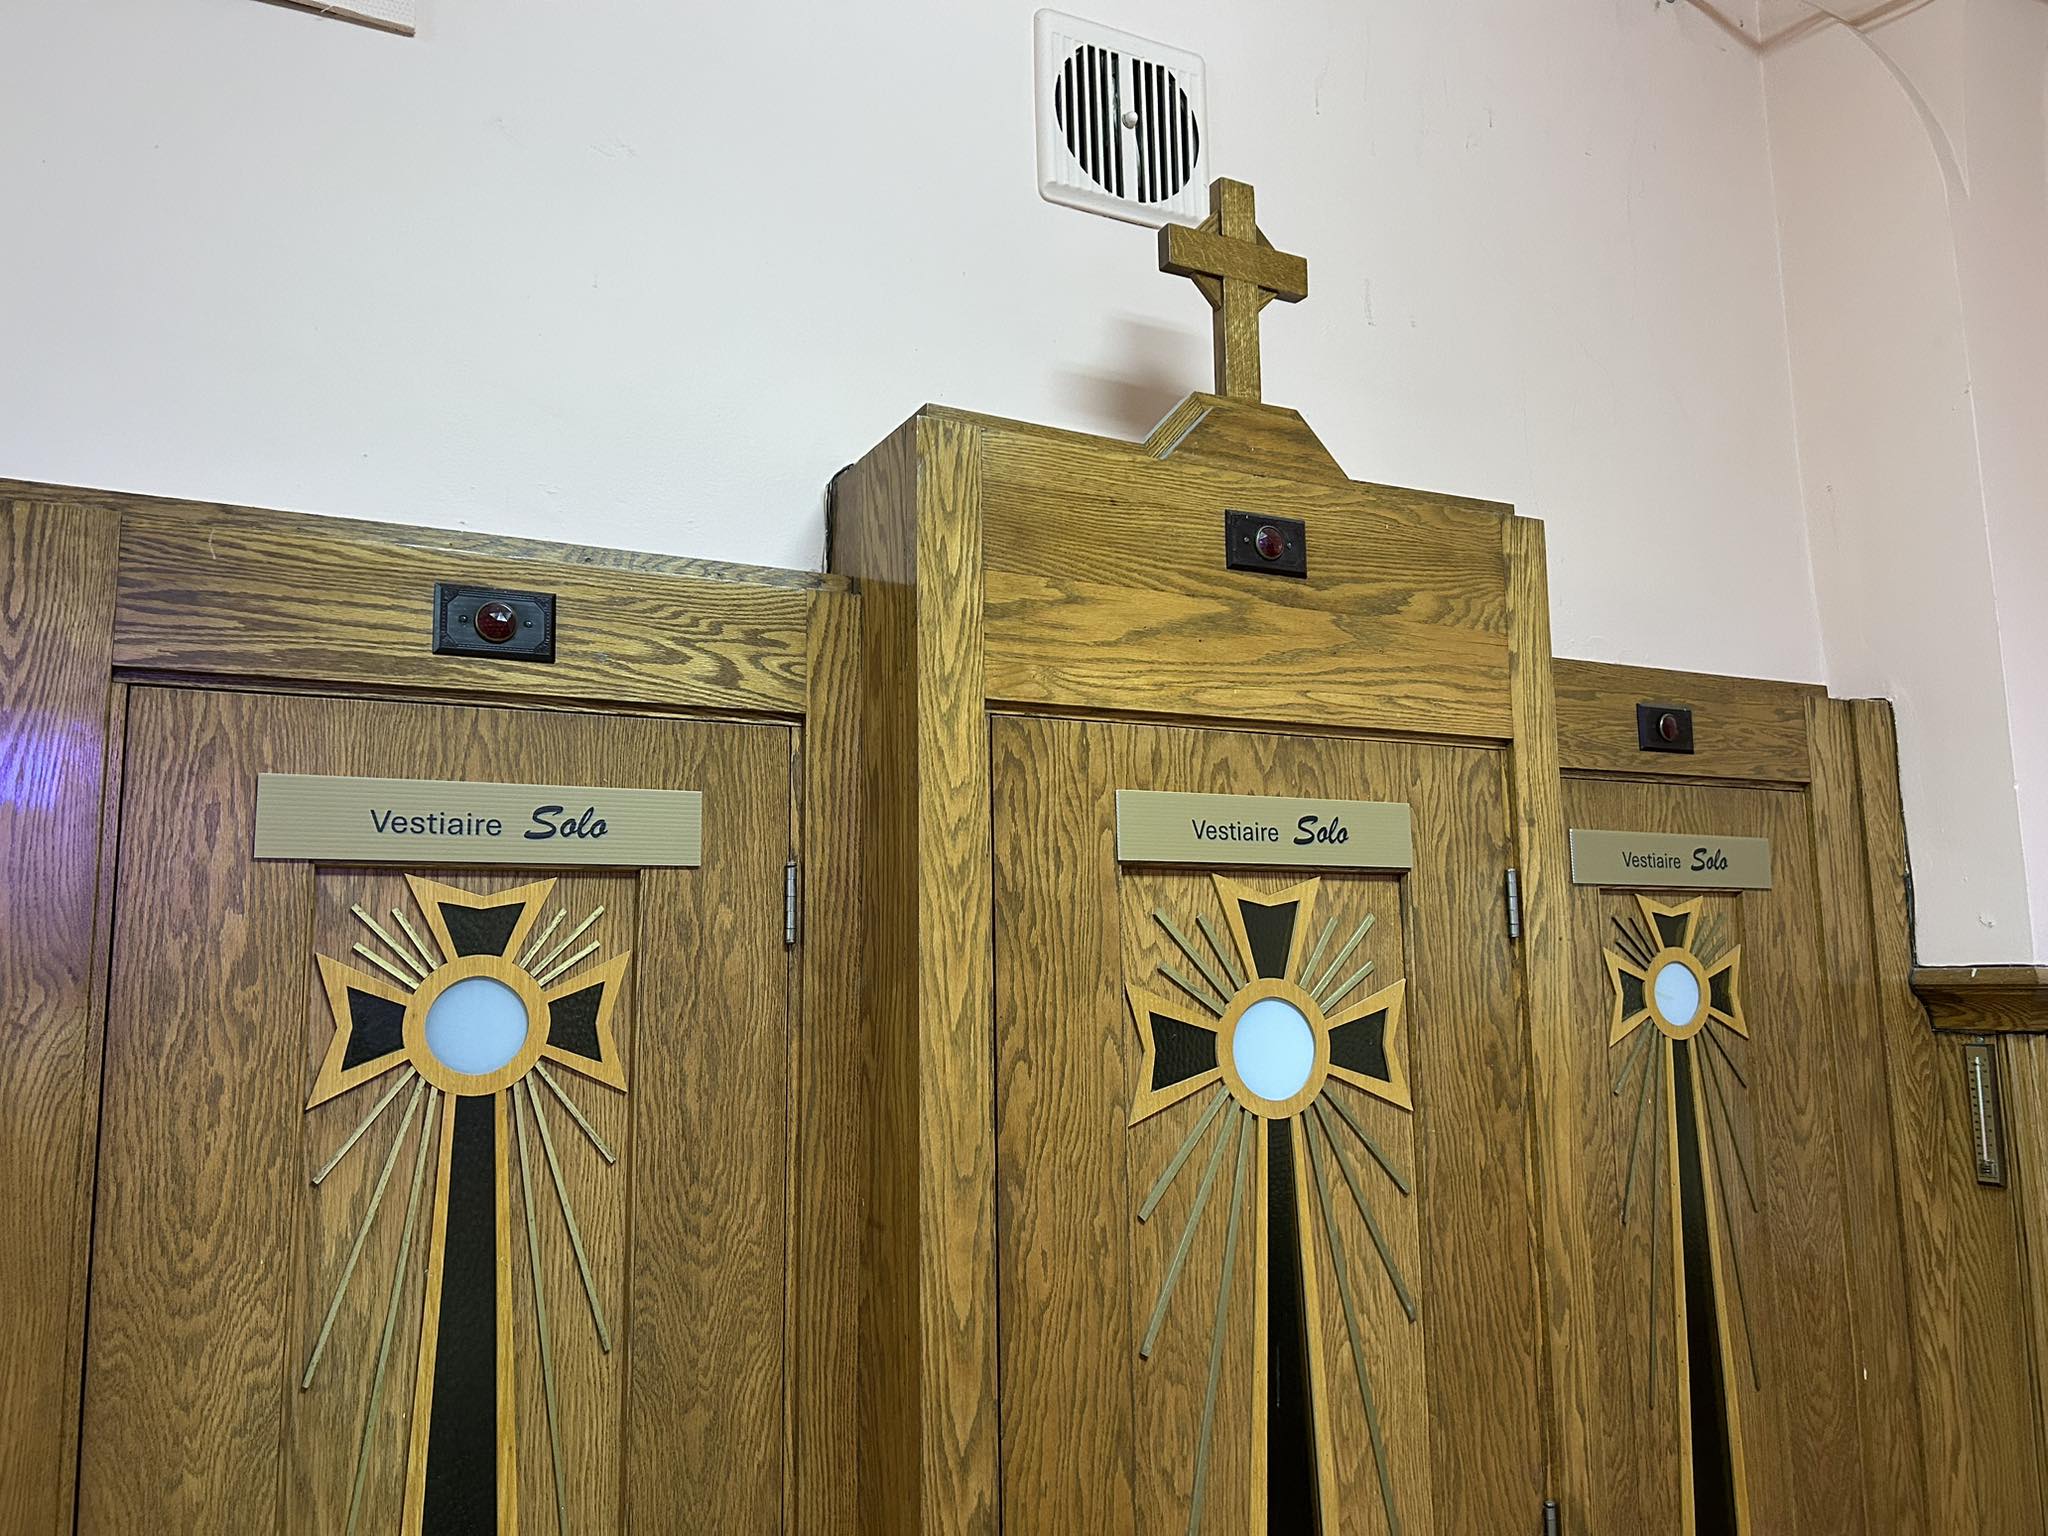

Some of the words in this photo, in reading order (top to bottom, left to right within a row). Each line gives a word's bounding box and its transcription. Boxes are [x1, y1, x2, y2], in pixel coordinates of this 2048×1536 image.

[370, 809, 502, 837] Vestiaire
[523, 805, 609, 840] Solo
[1191, 819, 1279, 842] Vestiaire
[1293, 815, 1350, 846] Solo
[1621, 851, 1681, 870] Vestiaire
[1690, 847, 1729, 872] Solo
